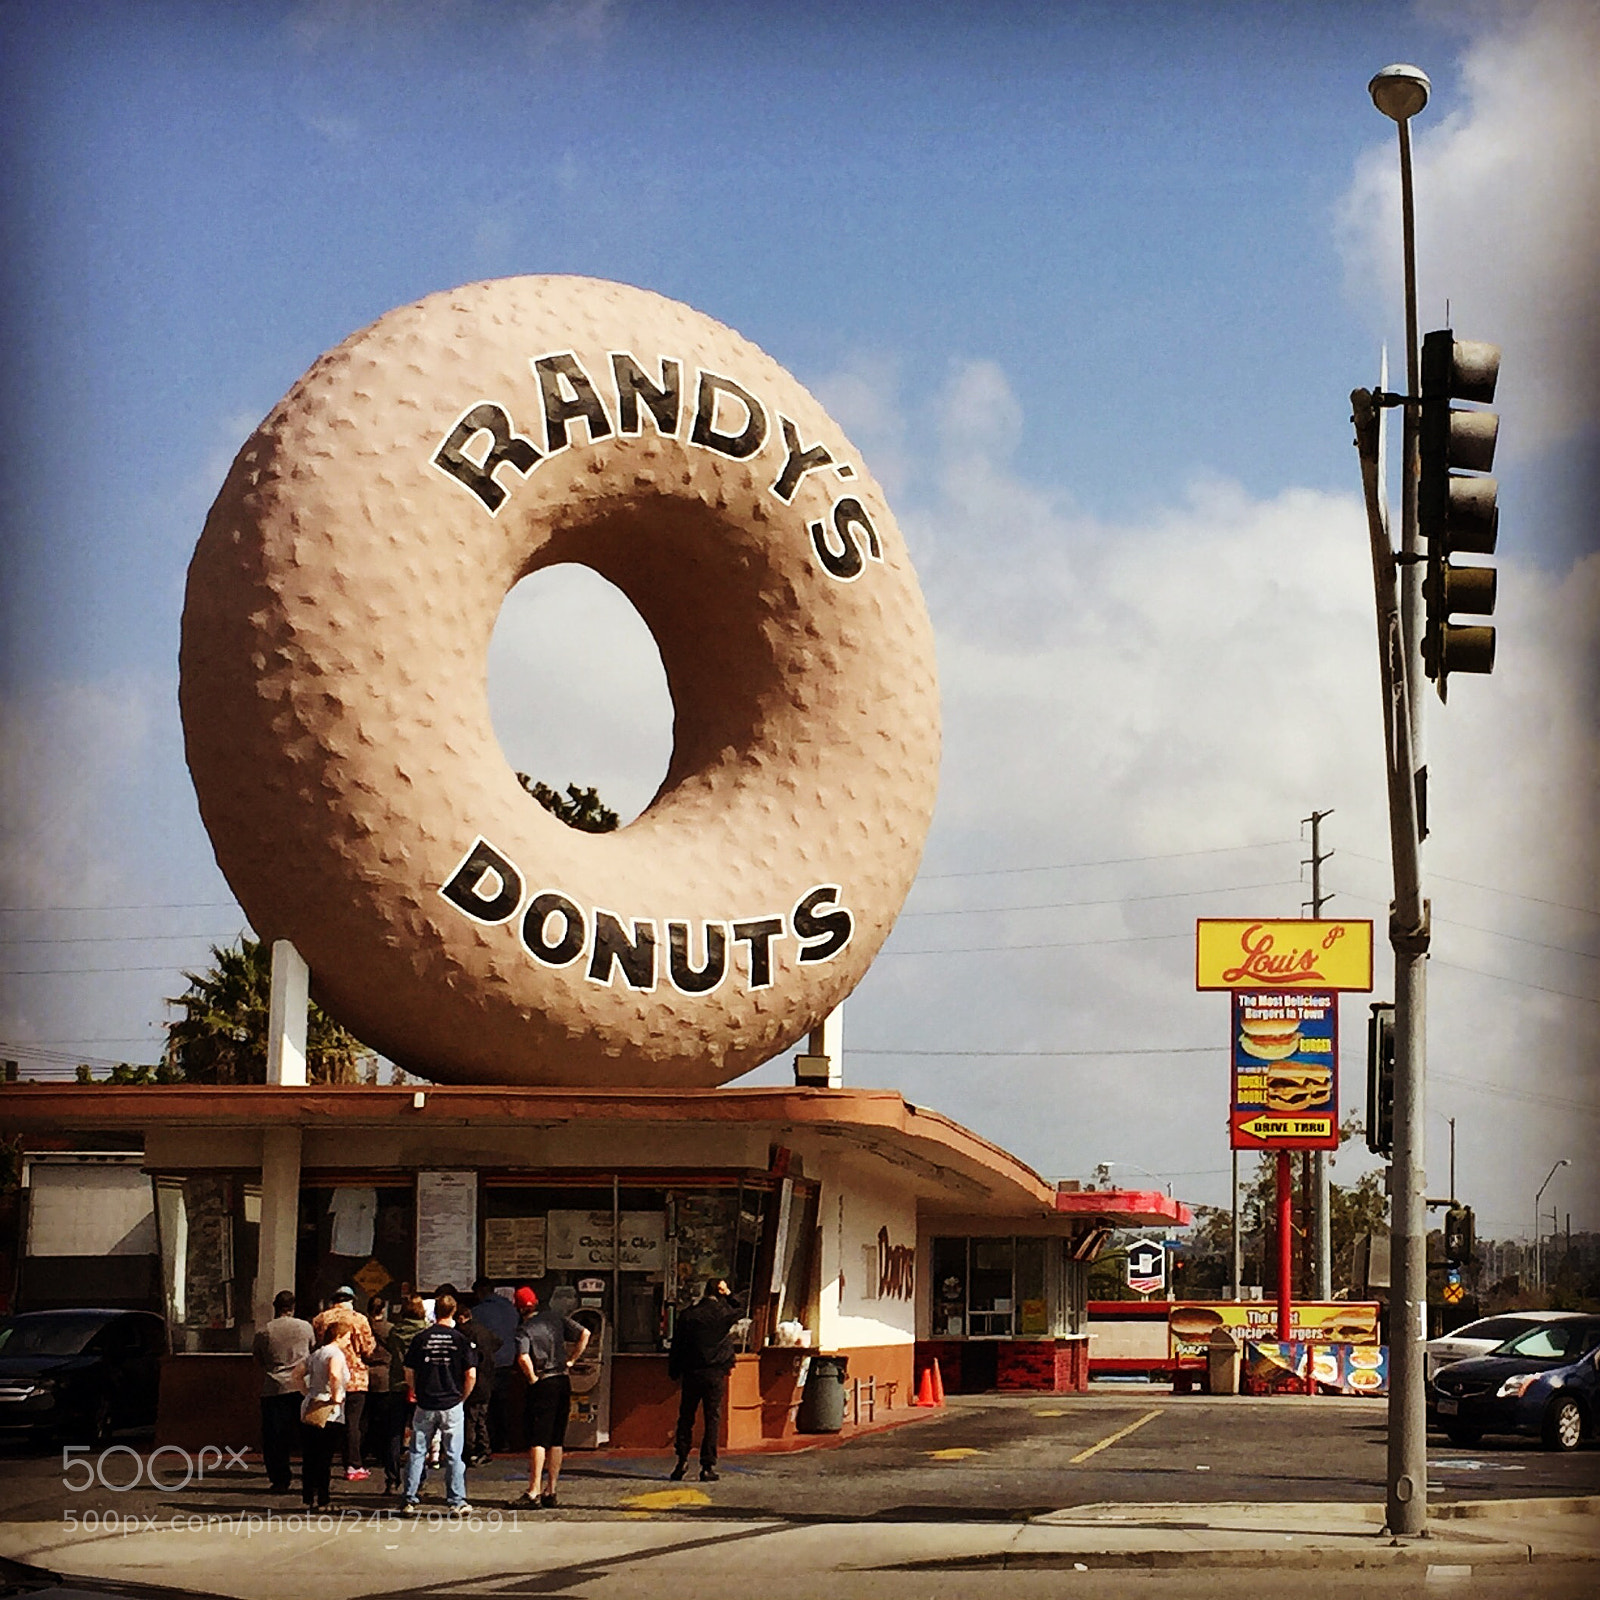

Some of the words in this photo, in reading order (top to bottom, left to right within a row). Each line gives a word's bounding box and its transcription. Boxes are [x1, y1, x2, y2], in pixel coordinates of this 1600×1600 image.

[429, 349, 885, 583] RANDY'S
[437, 834, 856, 997] DONUTS
[1222, 924, 1326, 983] Louis
[1239, 995, 1257, 1007] The
[1254, 1122, 1288, 1132] DRIVE
[1294, 1122, 1325, 1132] THRU
[1247, 1310, 1268, 1324] The
